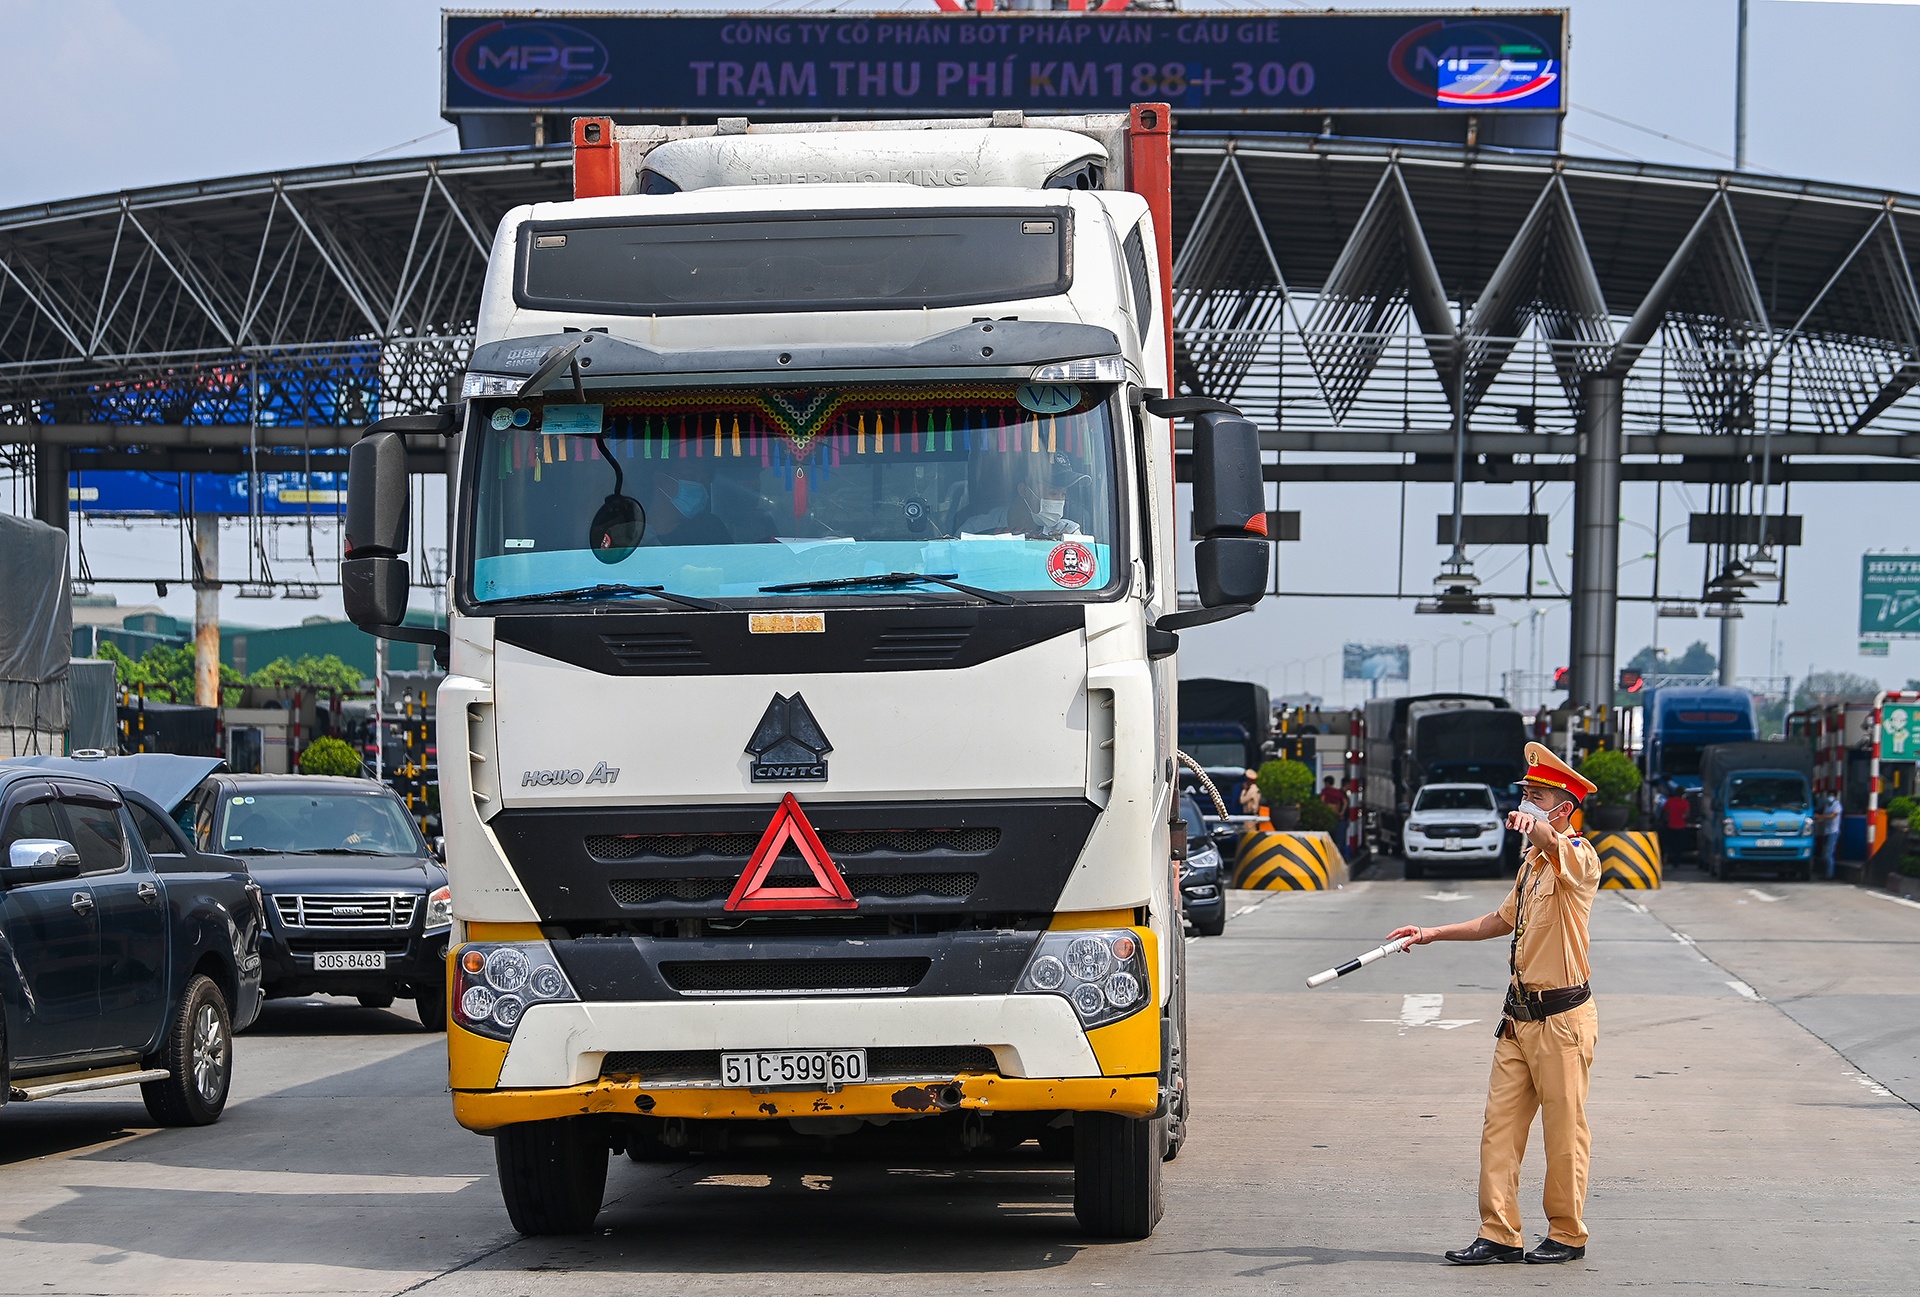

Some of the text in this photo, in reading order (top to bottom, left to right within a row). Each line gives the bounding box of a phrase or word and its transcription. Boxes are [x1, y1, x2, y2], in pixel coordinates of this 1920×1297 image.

[720, 20, 792, 45] CÔNG
[798, 23, 830, 44] TY
[958, 23, 1011, 44] BOT
[1018, 19, 1091, 44] PHÁP
[1098, 20, 1153, 44] VÂN
[477, 45, 595, 71] MPC
[689, 53, 1316, 106] TRẠM THU PHÍ KM188+300
[751, 169, 969, 187] THERMO KING
[1025, 385, 1073, 407] VN
[585, 760, 621, 784] A7
[755, 766, 822, 777] CNHTC
[726, 1053, 861, 1083] 51C-59960
